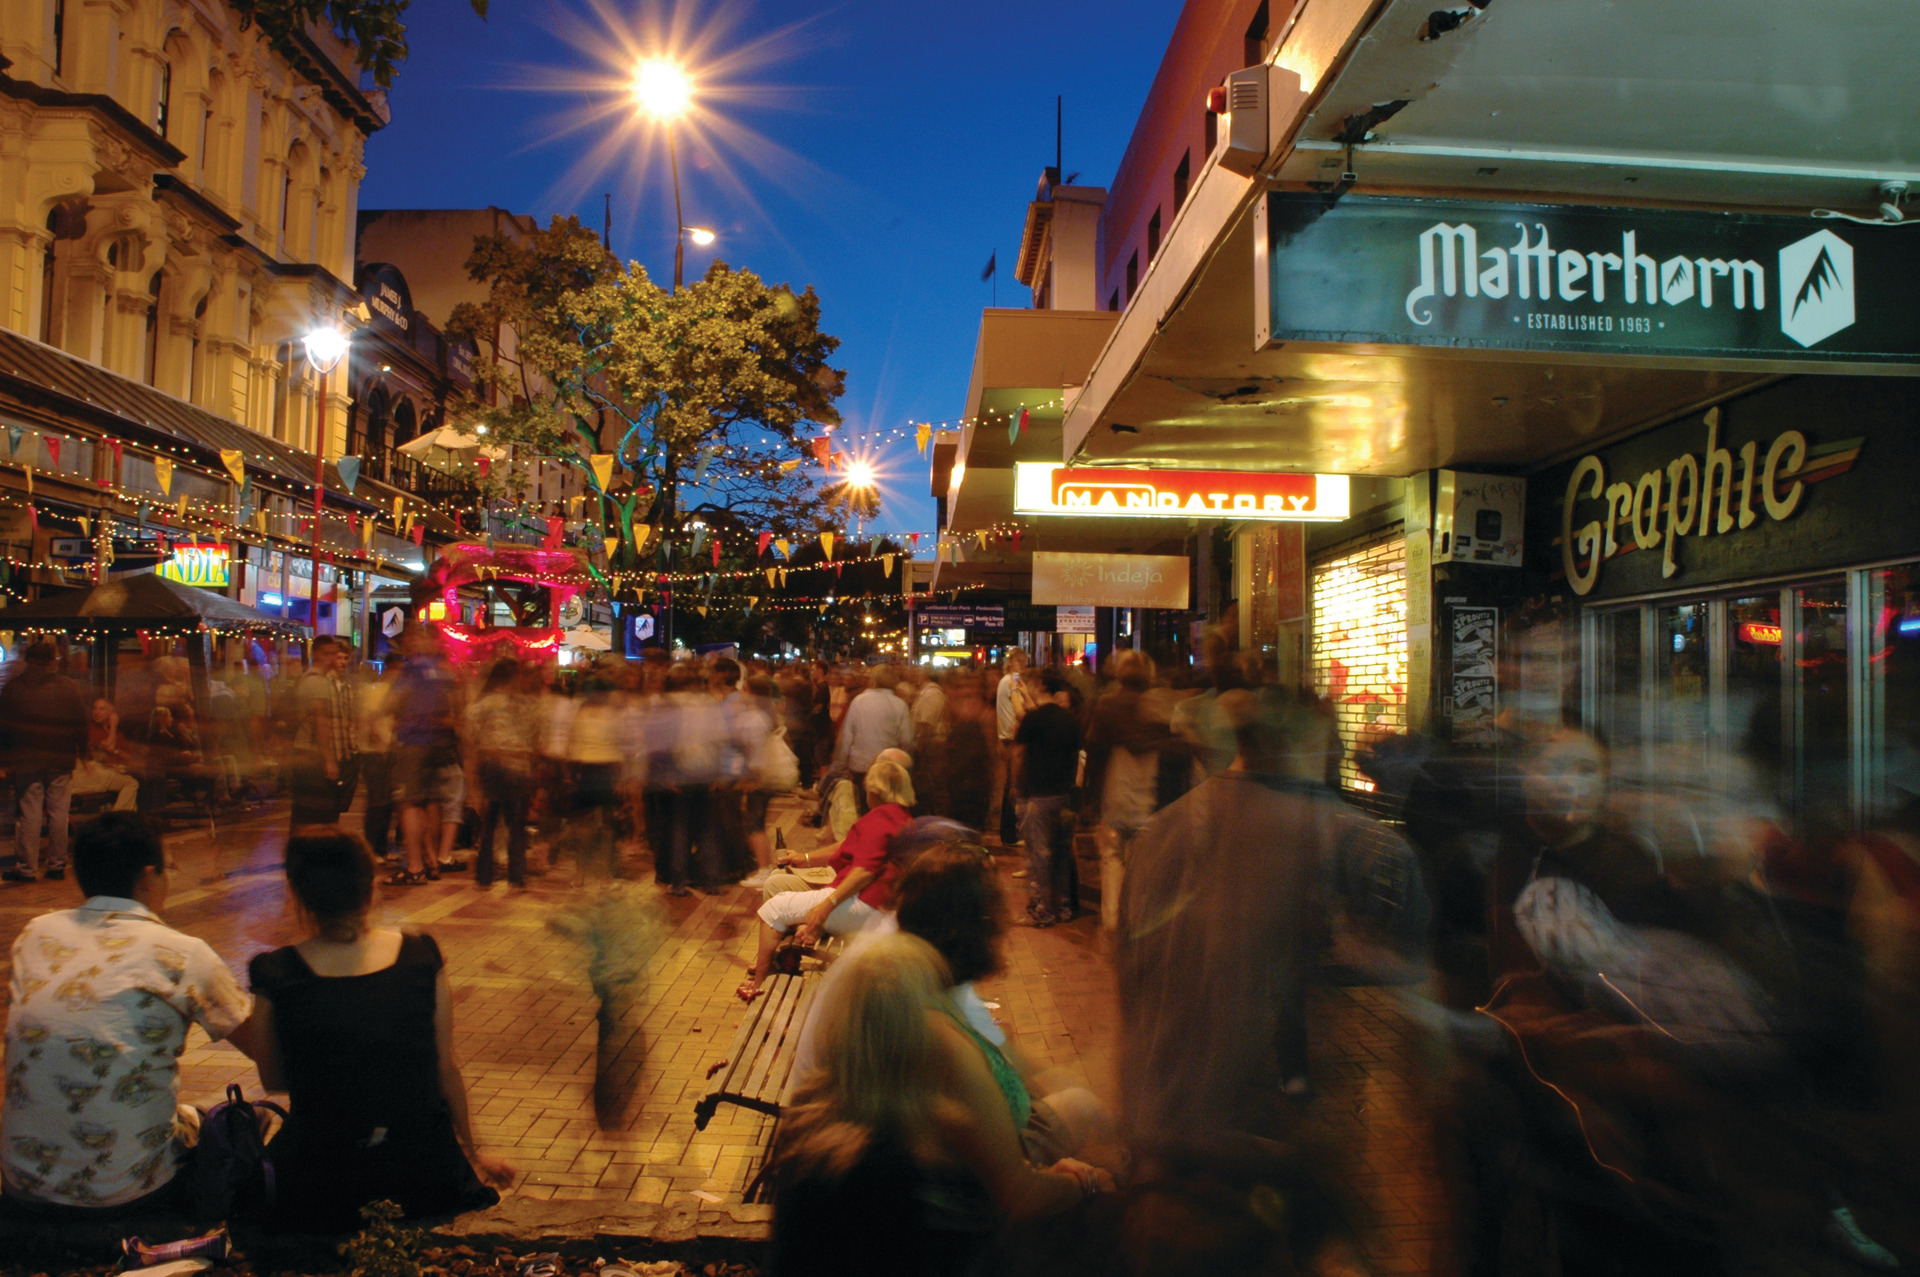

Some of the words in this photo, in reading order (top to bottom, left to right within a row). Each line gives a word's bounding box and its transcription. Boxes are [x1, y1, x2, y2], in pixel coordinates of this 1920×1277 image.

[1405, 221, 1765, 326] Matterhorn
[1527, 313, 1613, 332] ESTABLISHED
[1619, 317, 1651, 333] 1963
[1065, 490, 1310, 513] MANDATORY
